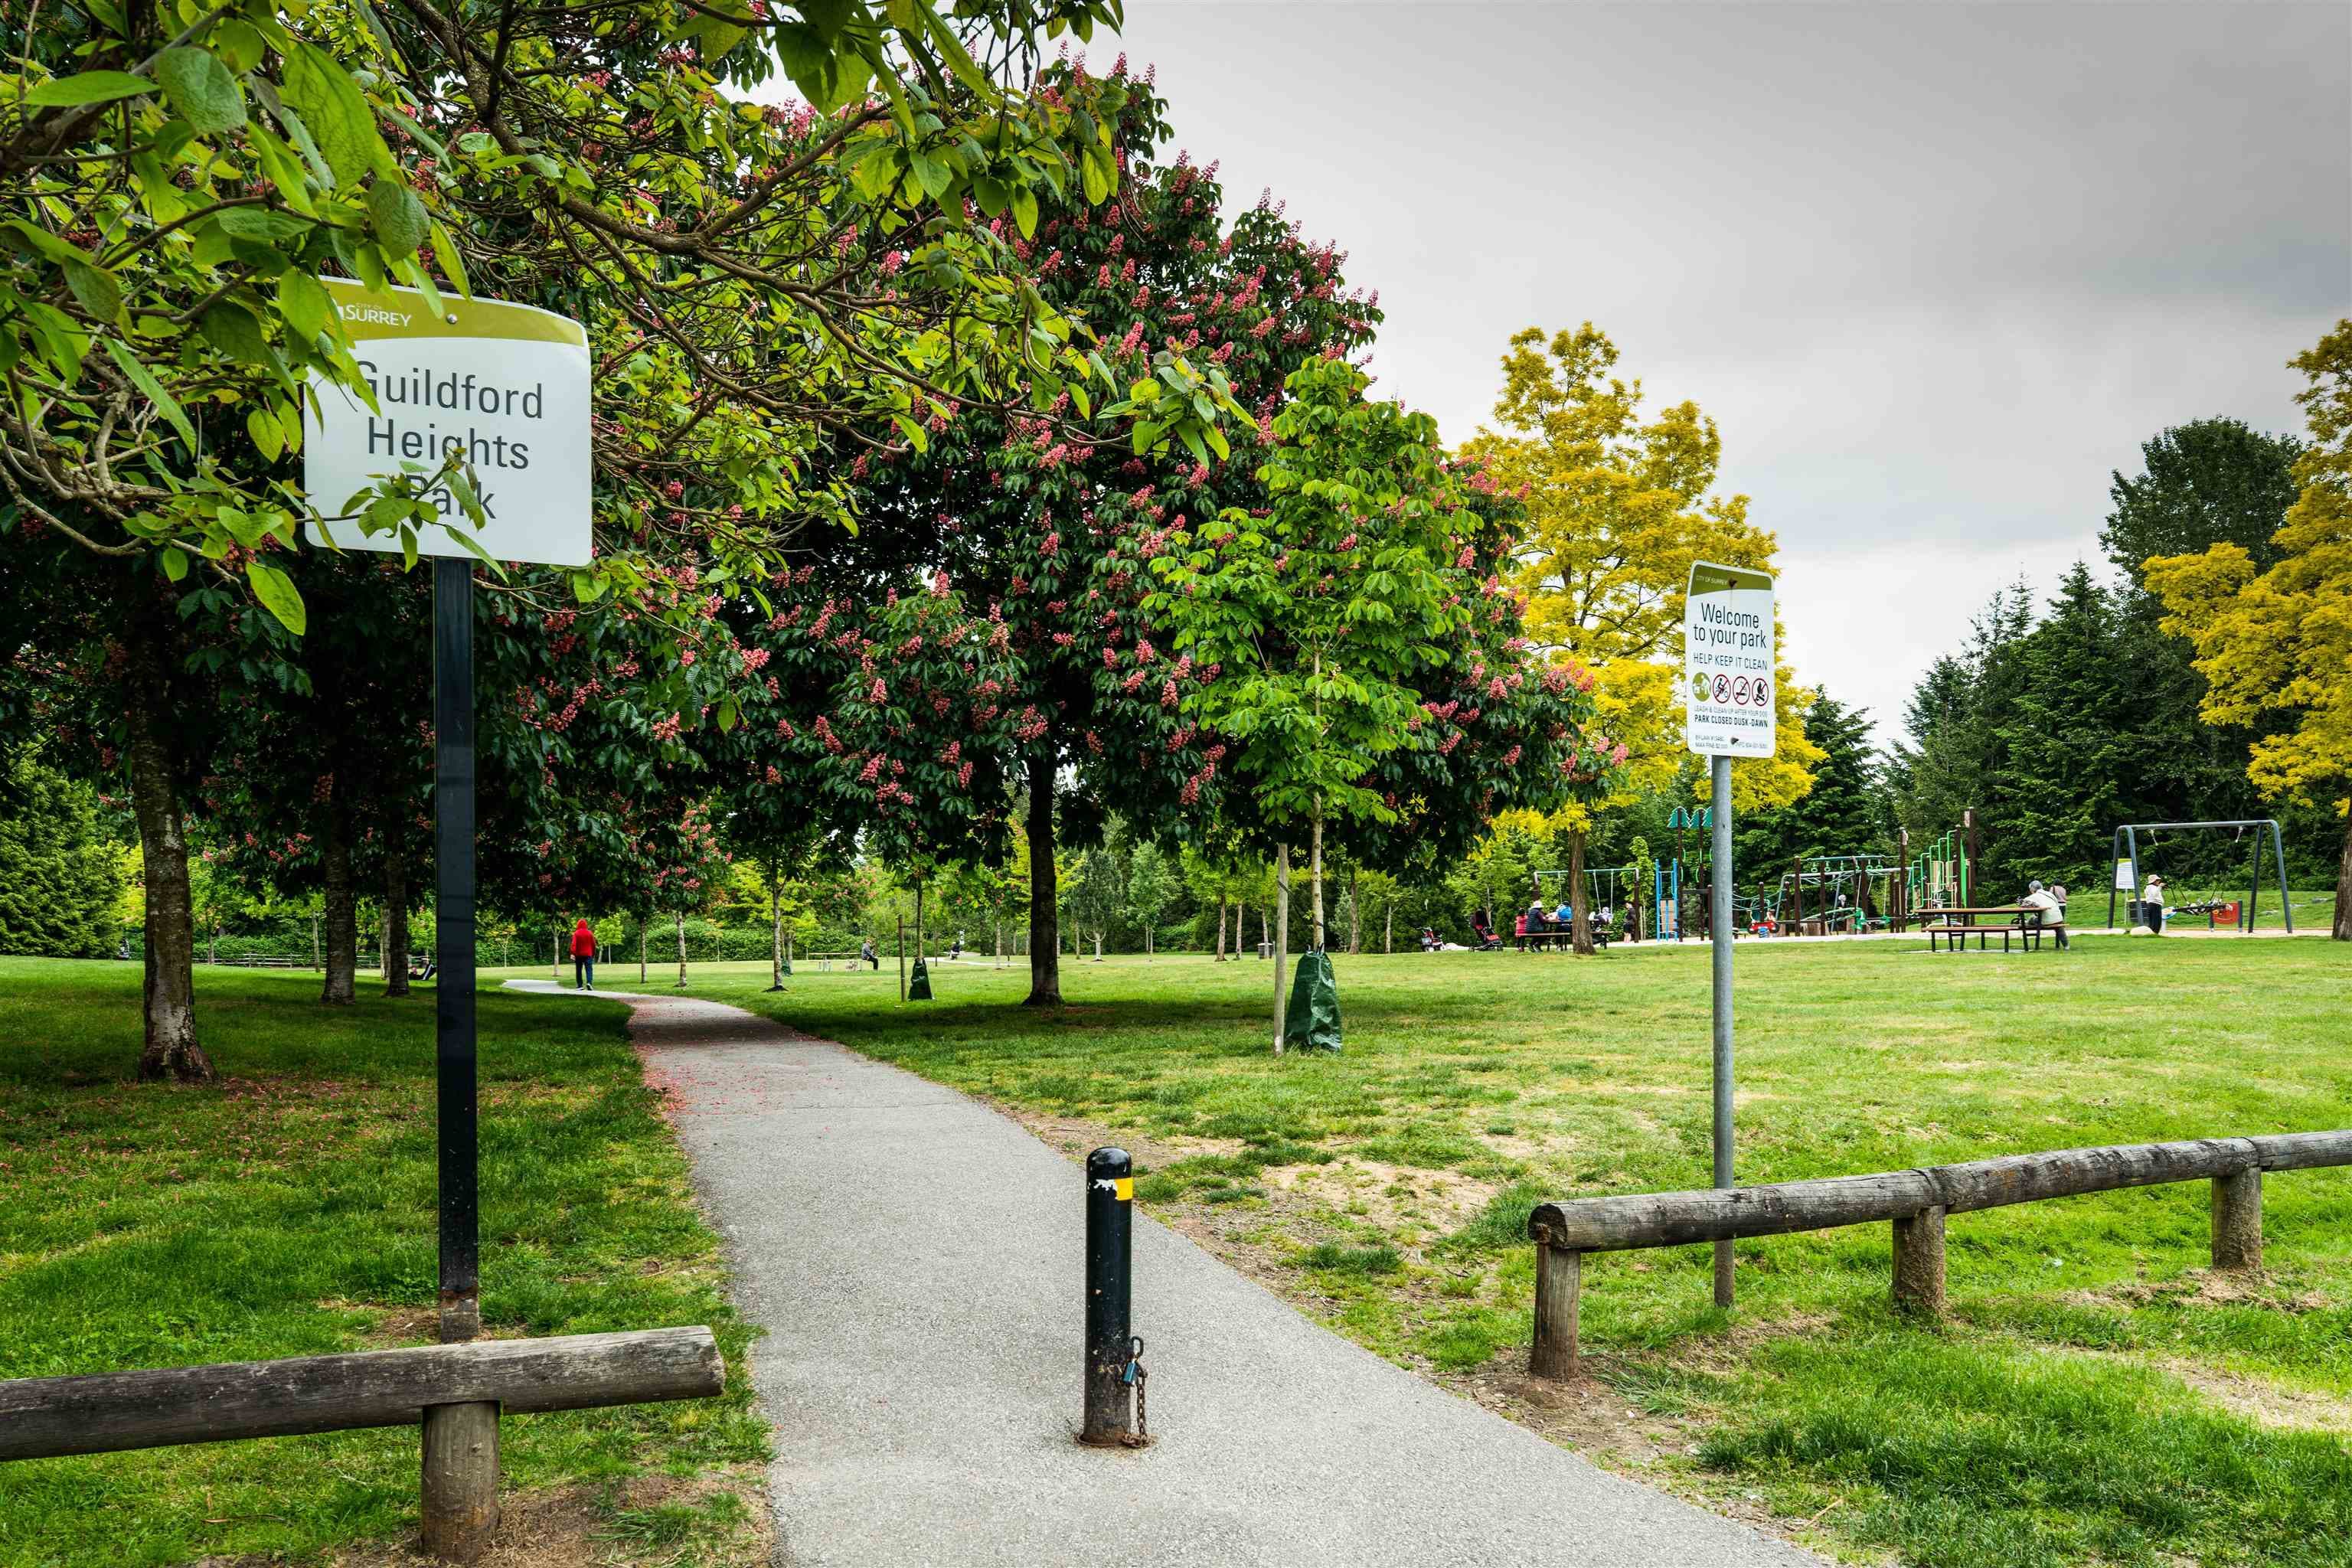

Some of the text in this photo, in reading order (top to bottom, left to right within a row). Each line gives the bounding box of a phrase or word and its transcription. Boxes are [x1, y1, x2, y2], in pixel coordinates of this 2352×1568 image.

[345, 304, 412, 327] SURREY
[407, 474, 497, 519] Pak
[1700, 603, 1759, 629] Welcome
[1693, 623, 1767, 650] to your park
[1693, 652, 1768, 671] HELP KEEP IT CLEAN
[1694, 714, 1710, 724] PARK
[1711, 715, 1733, 725] CLOSED
